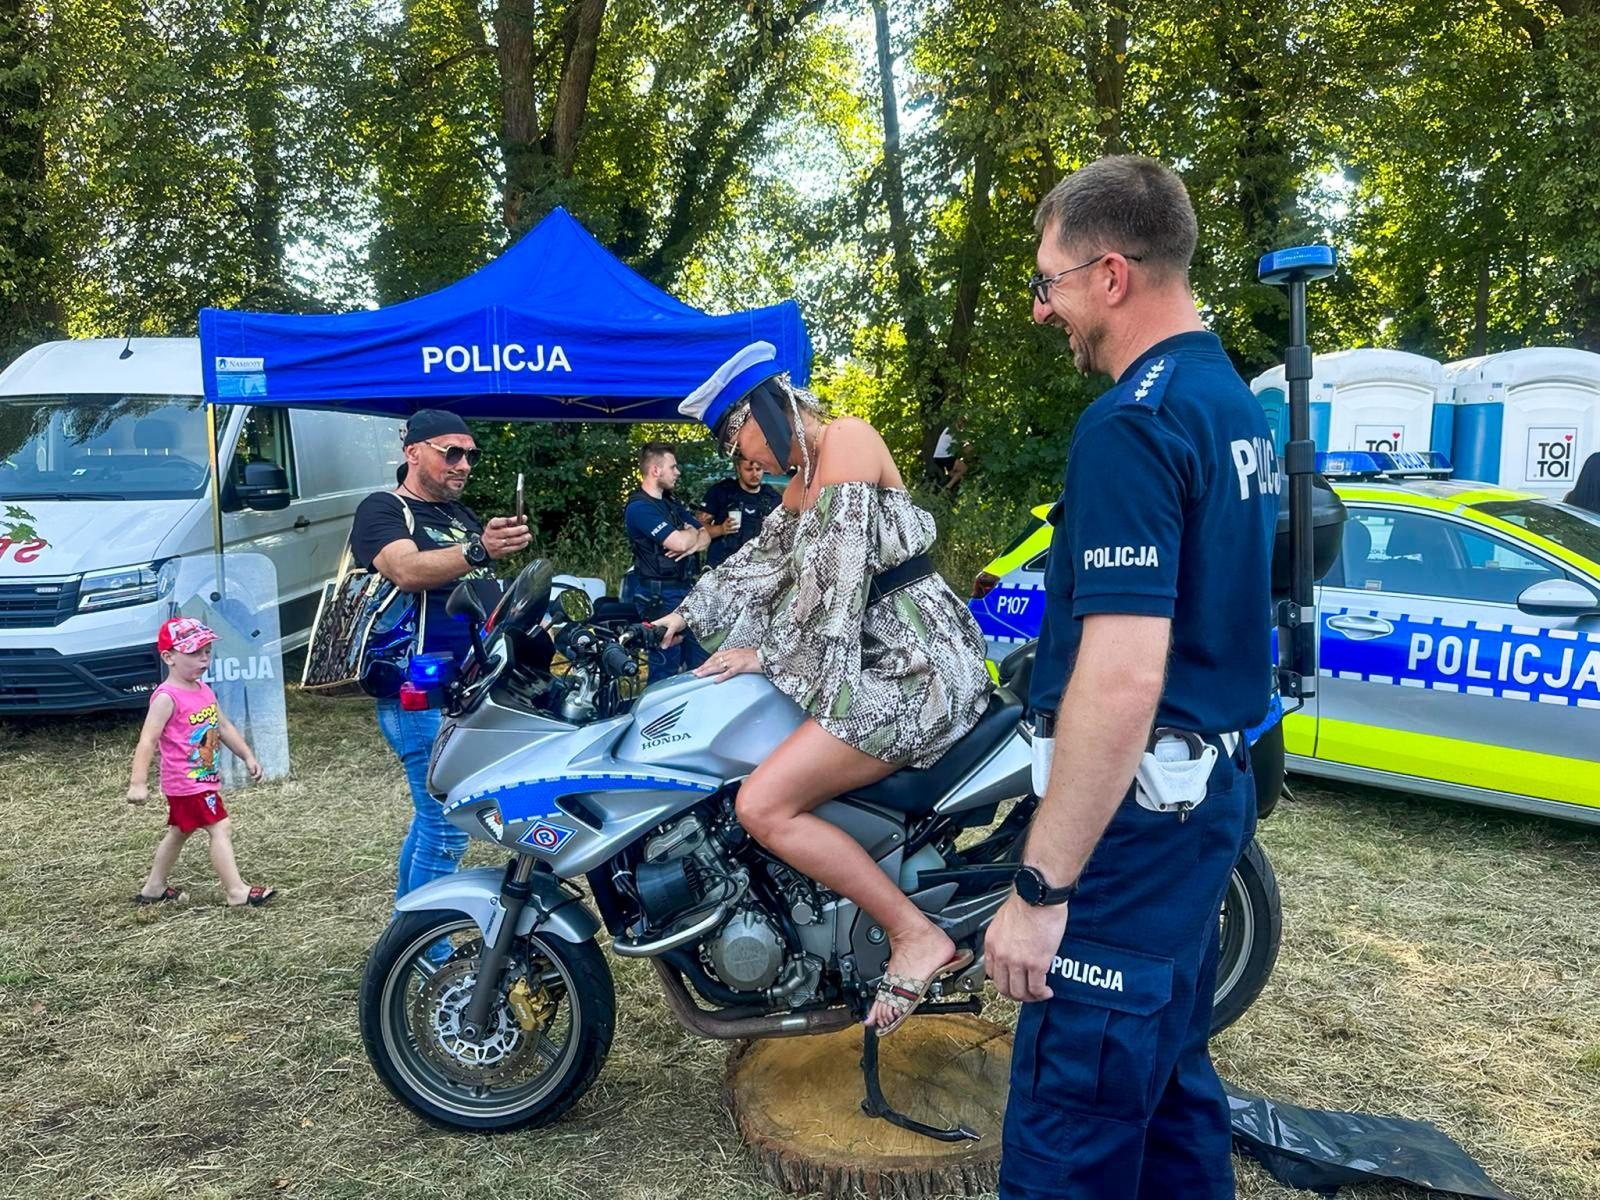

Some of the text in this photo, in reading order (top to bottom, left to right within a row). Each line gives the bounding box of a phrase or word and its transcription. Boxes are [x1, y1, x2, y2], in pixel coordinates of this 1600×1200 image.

[421, 343, 573, 374] POLICJA
[1538, 441, 1571, 460] TOI
[1537, 460, 1570, 478] TOI
[1083, 545, 1160, 571] POLICJA
[996, 595, 1030, 615] P107
[201, 655, 275, 683] LICJA
[1407, 632, 1600, 693] POLICJA
[642, 732, 692, 751] HONDA
[1050, 955, 1124, 993] POLICJA
